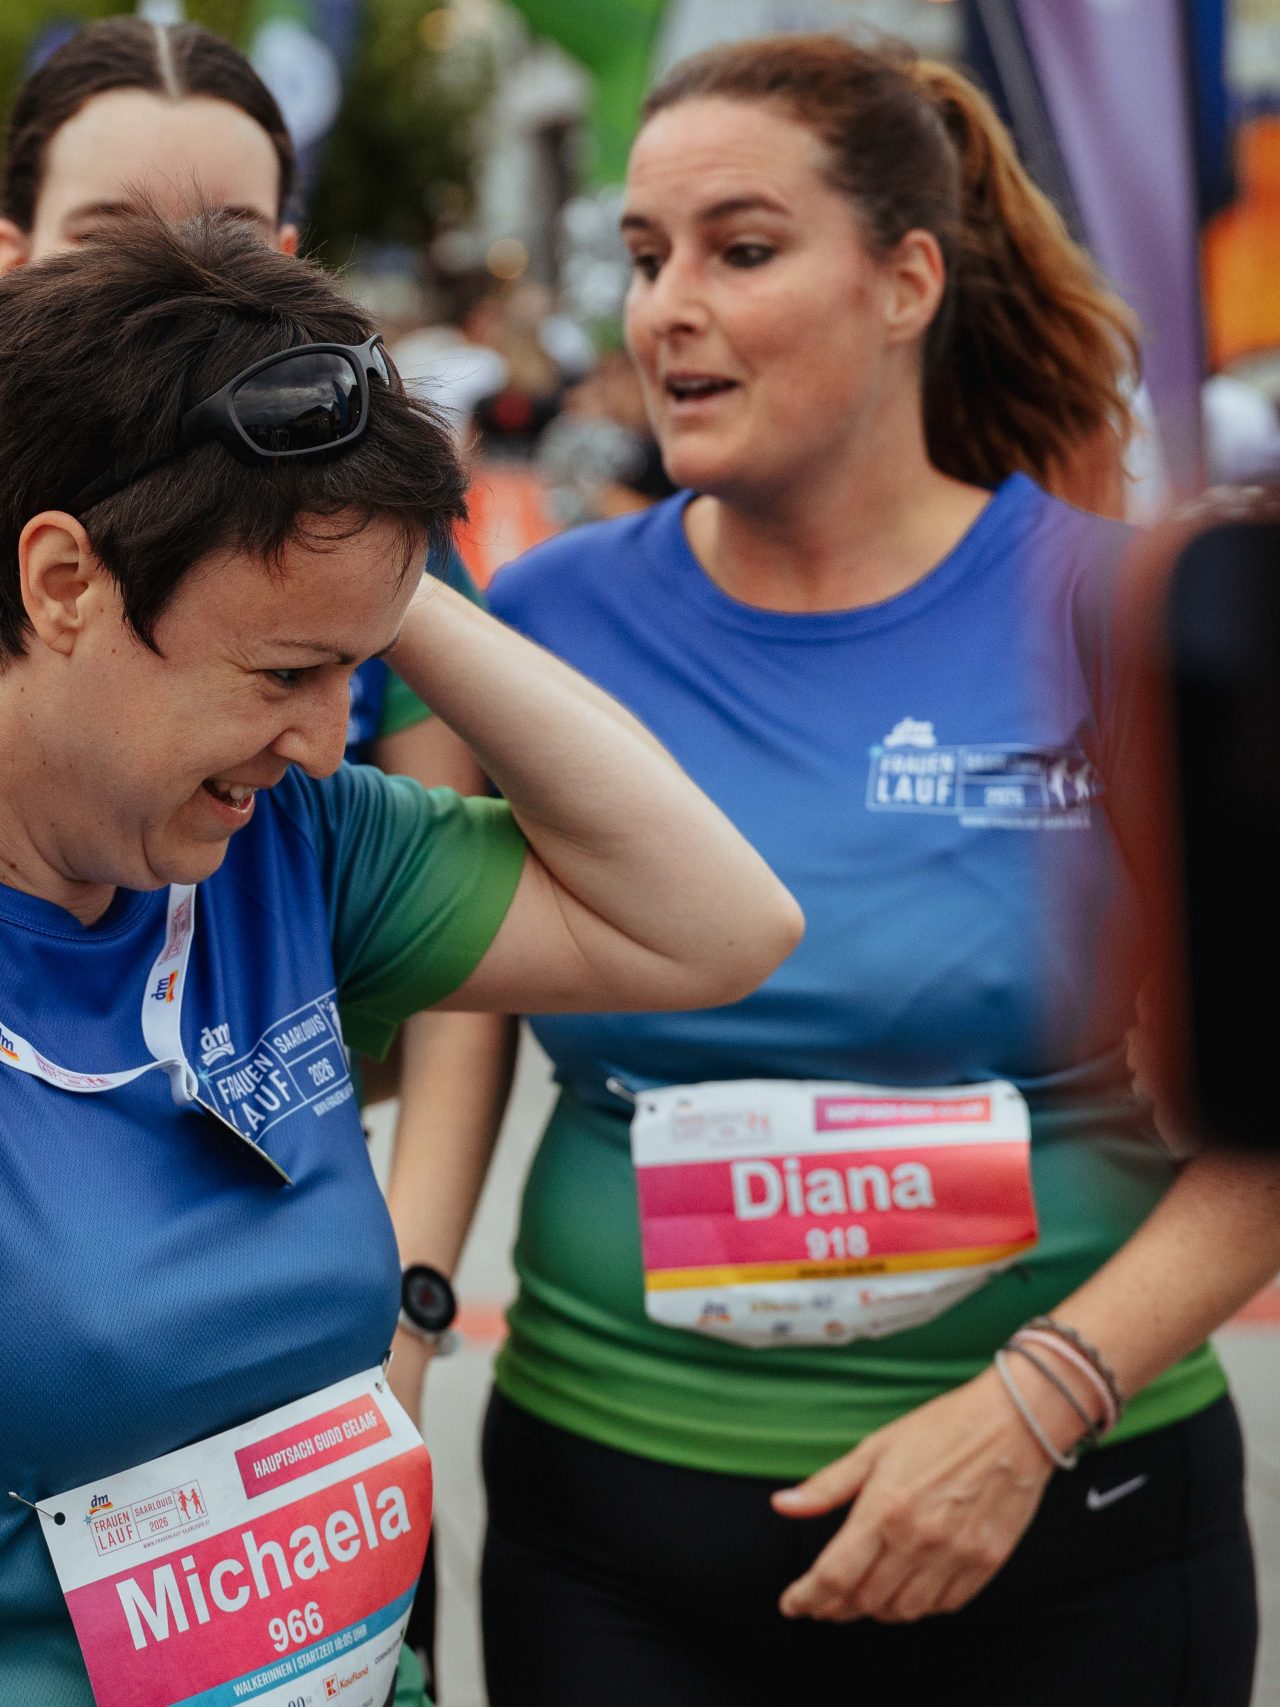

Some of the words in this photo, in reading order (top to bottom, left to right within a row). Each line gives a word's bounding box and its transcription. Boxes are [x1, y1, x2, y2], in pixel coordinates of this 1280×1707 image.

[876, 774, 952, 805] LAUF
[151, 977, 170, 1001] dm
[200, 1022, 230, 1051] dm
[273, 1014, 327, 1054] SAARLOUIS
[216, 1052, 274, 1105] FRAUEN
[307, 1057, 335, 1087] 2026
[730, 1156, 936, 1221] Diana
[804, 1225, 870, 1262] 918
[252, 1437, 316, 1479] HAUPTSACH
[313, 1426, 344, 1452] GUDD
[341, 1410, 379, 1439] GELAAF
[91, 1493, 109, 1508] dm
[134, 1496, 173, 1517] SAARLOUIS
[93, 1511, 130, 1534] FRAUEN
[98, 1523, 134, 1551] LAUF
[149, 1516, 169, 1532] 2026
[115, 1481, 412, 1651] Michaela
[268, 1601, 325, 1652] 966
[233, 1659, 293, 1697] WALKERINNEN
[297, 1642, 334, 1672] STARTZEIT
[333, 1634, 354, 1653] 18:05
[352, 1623, 368, 1643] UHR
[339, 1665, 369, 1690] Kaufland
